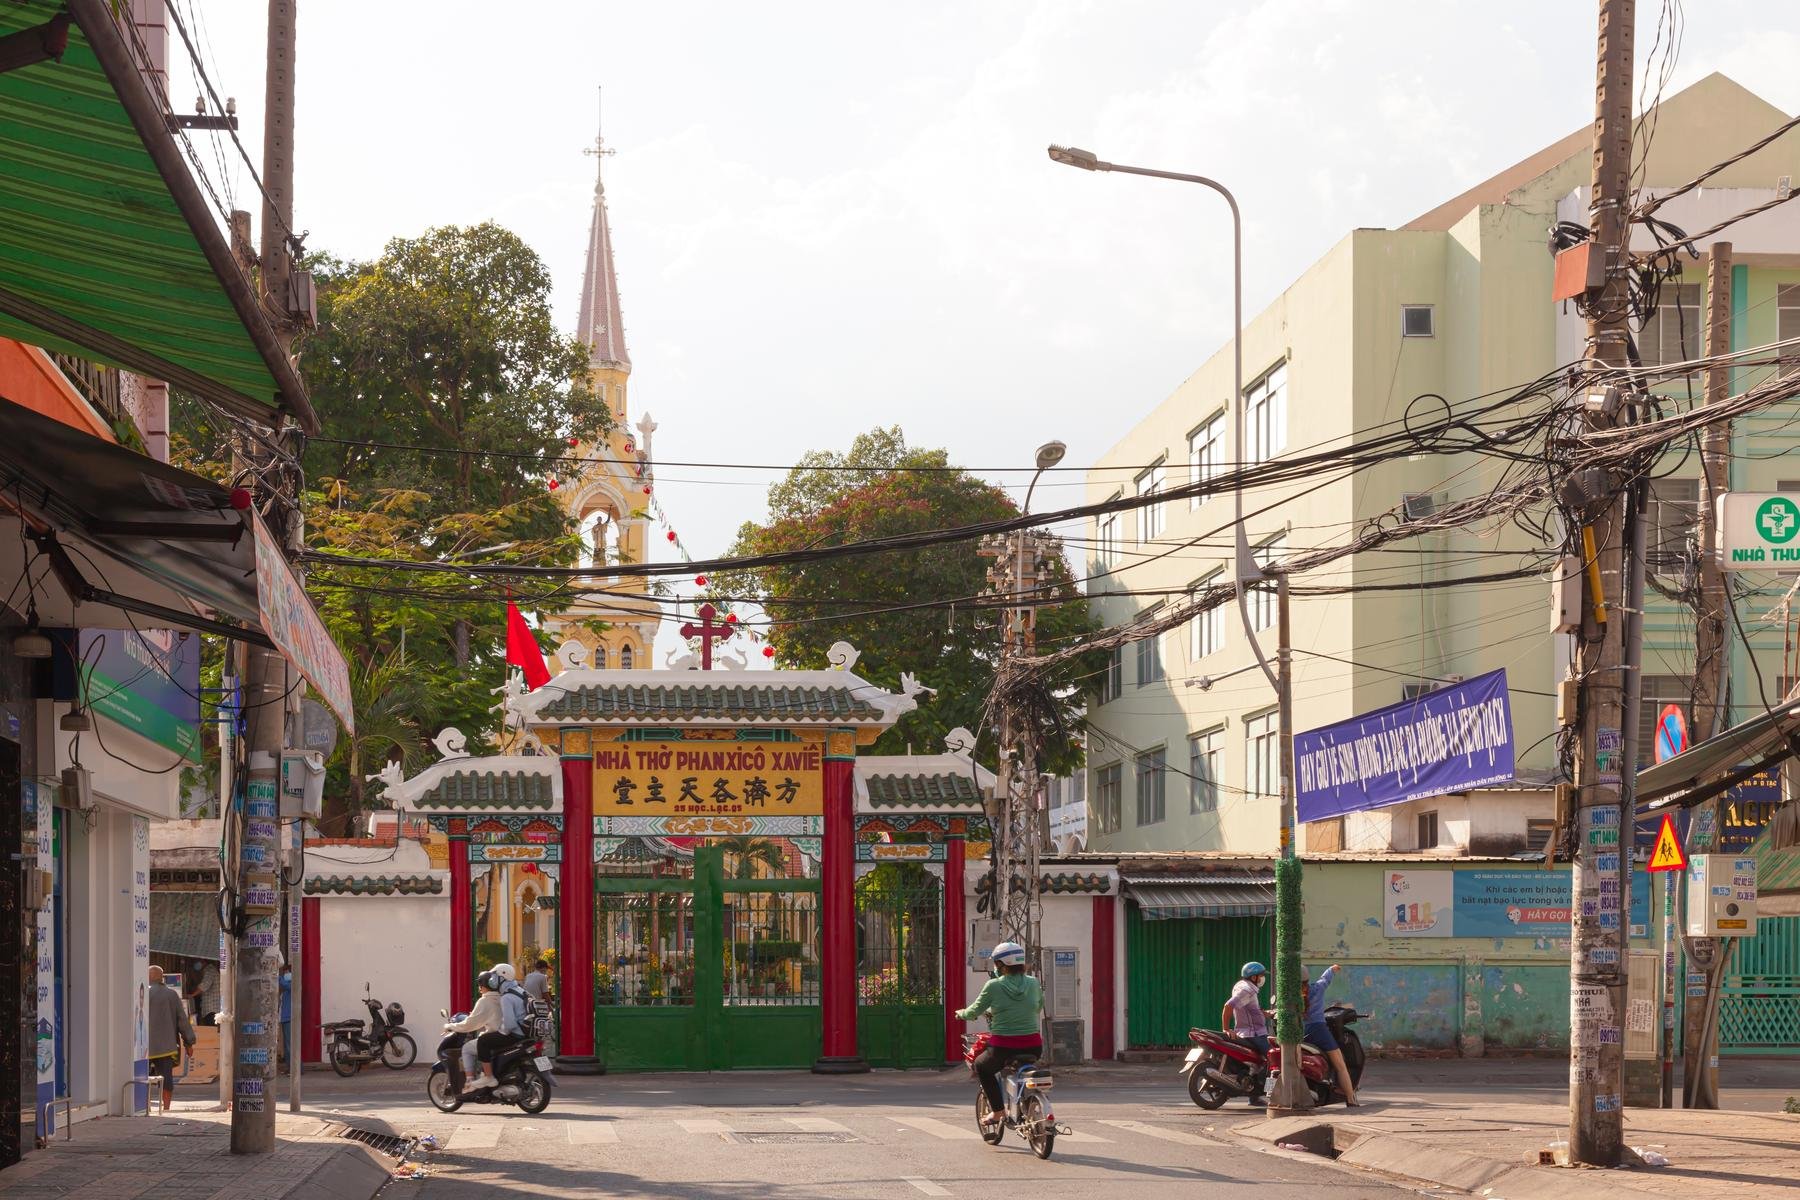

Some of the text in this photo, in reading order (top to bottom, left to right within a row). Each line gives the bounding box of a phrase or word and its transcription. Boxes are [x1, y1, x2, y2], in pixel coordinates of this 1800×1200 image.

[1732, 546, 1765, 562] NHÀ
[596, 744, 632, 770] NHÀ
[636, 745, 673, 770] THỜ
[676, 745, 766, 771] PHANXICÔ
[1486, 885, 1500, 893] Khi
[1503, 885, 1517, 893] các
[1535, 885, 1544, 894] bị
[1546, 886, 1567, 894] hoặc
[1478, 897, 1491, 905] nạt
[1493, 896, 1509, 905] bạo
[1512, 896, 1526, 905] lực
[1528, 897, 1551, 905] trong
[1554, 896, 1564, 904] và
[1527, 908, 1566, 921] HÃY GỌI
